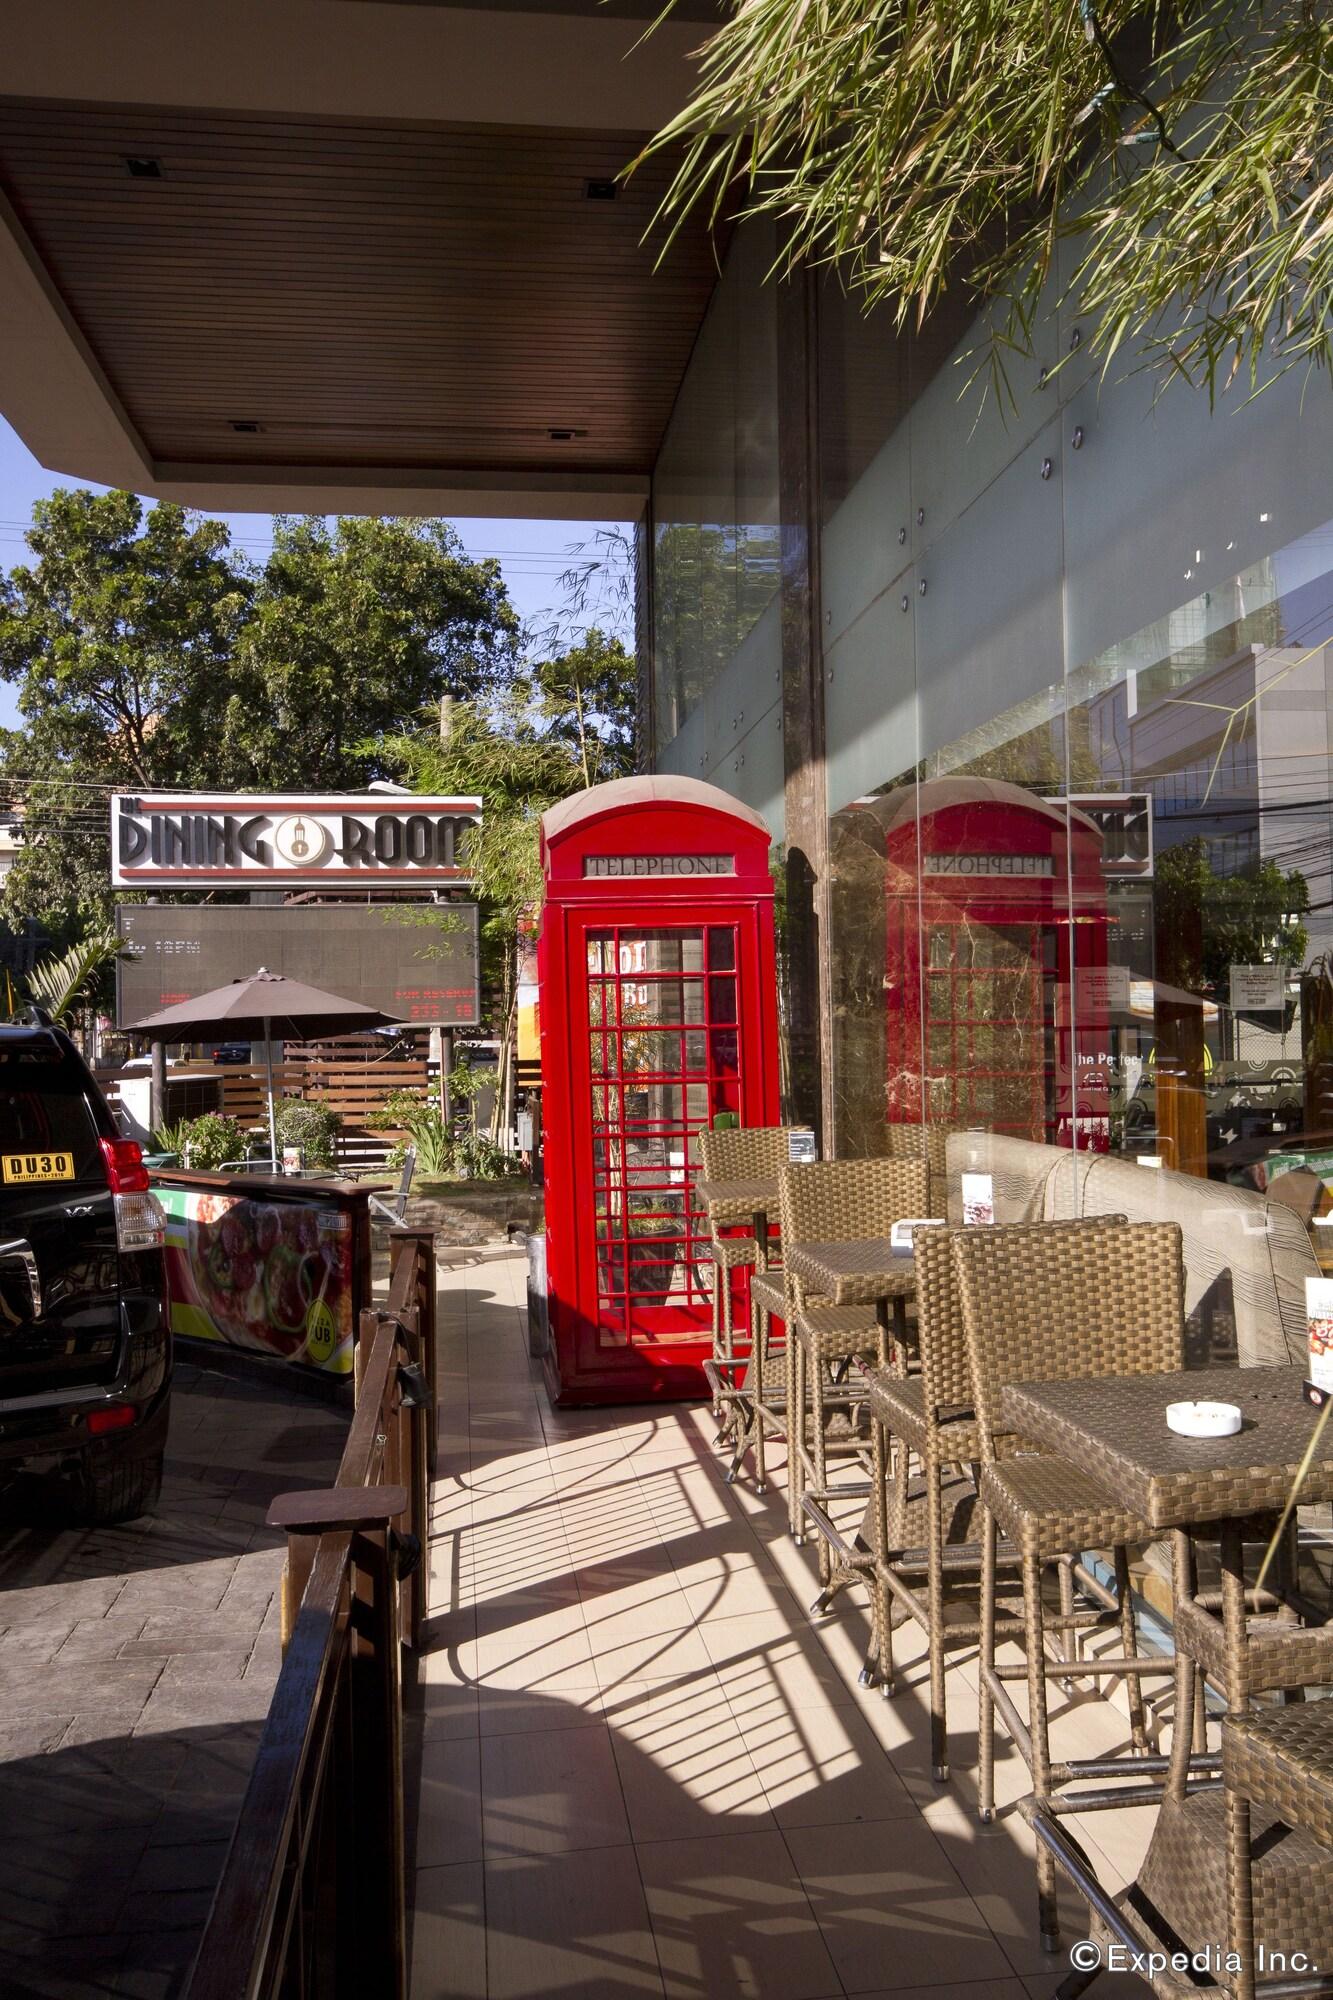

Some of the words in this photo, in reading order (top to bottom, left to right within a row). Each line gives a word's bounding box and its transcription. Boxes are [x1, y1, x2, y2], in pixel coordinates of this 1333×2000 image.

[119, 814, 265, 864] DINING
[333, 814, 477, 865] ROOM
[589, 856, 728, 875] TELEPHONE
[1098, 1052, 1143, 1066] Pefec
[10, 1156, 67, 1175] DU30
[64, 1205, 95, 1217] VX
